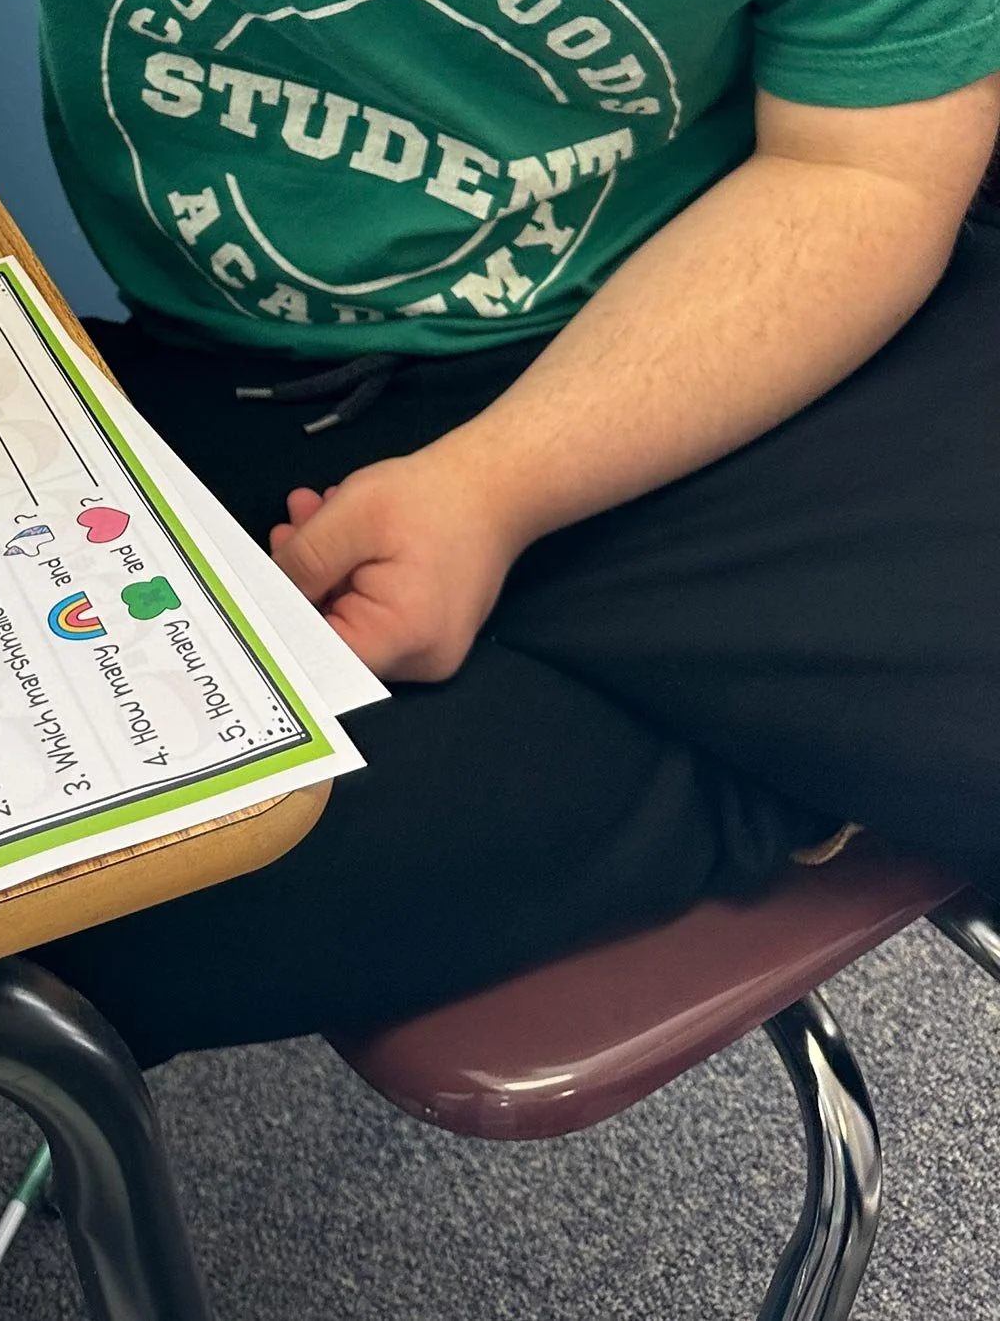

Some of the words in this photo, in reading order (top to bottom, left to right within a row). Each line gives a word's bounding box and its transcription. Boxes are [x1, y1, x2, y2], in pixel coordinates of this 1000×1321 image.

[141, 49, 636, 222] STUDENT
[80, 497, 104, 508] ?
[14, 513, 38, 525] ?
[38, 557, 72, 587] and
[109, 544, 144, 574] and
[163, 619, 206, 673] many
[93, 644, 133, 700] many
[193, 674, 234, 720] How
[120, 700, 159, 746] How
[217, 718, 247, 743] 5.
[33, 709, 79, 774] Which
[142, 744, 169, 766] 4.
[63, 773, 92, 796] 3.
